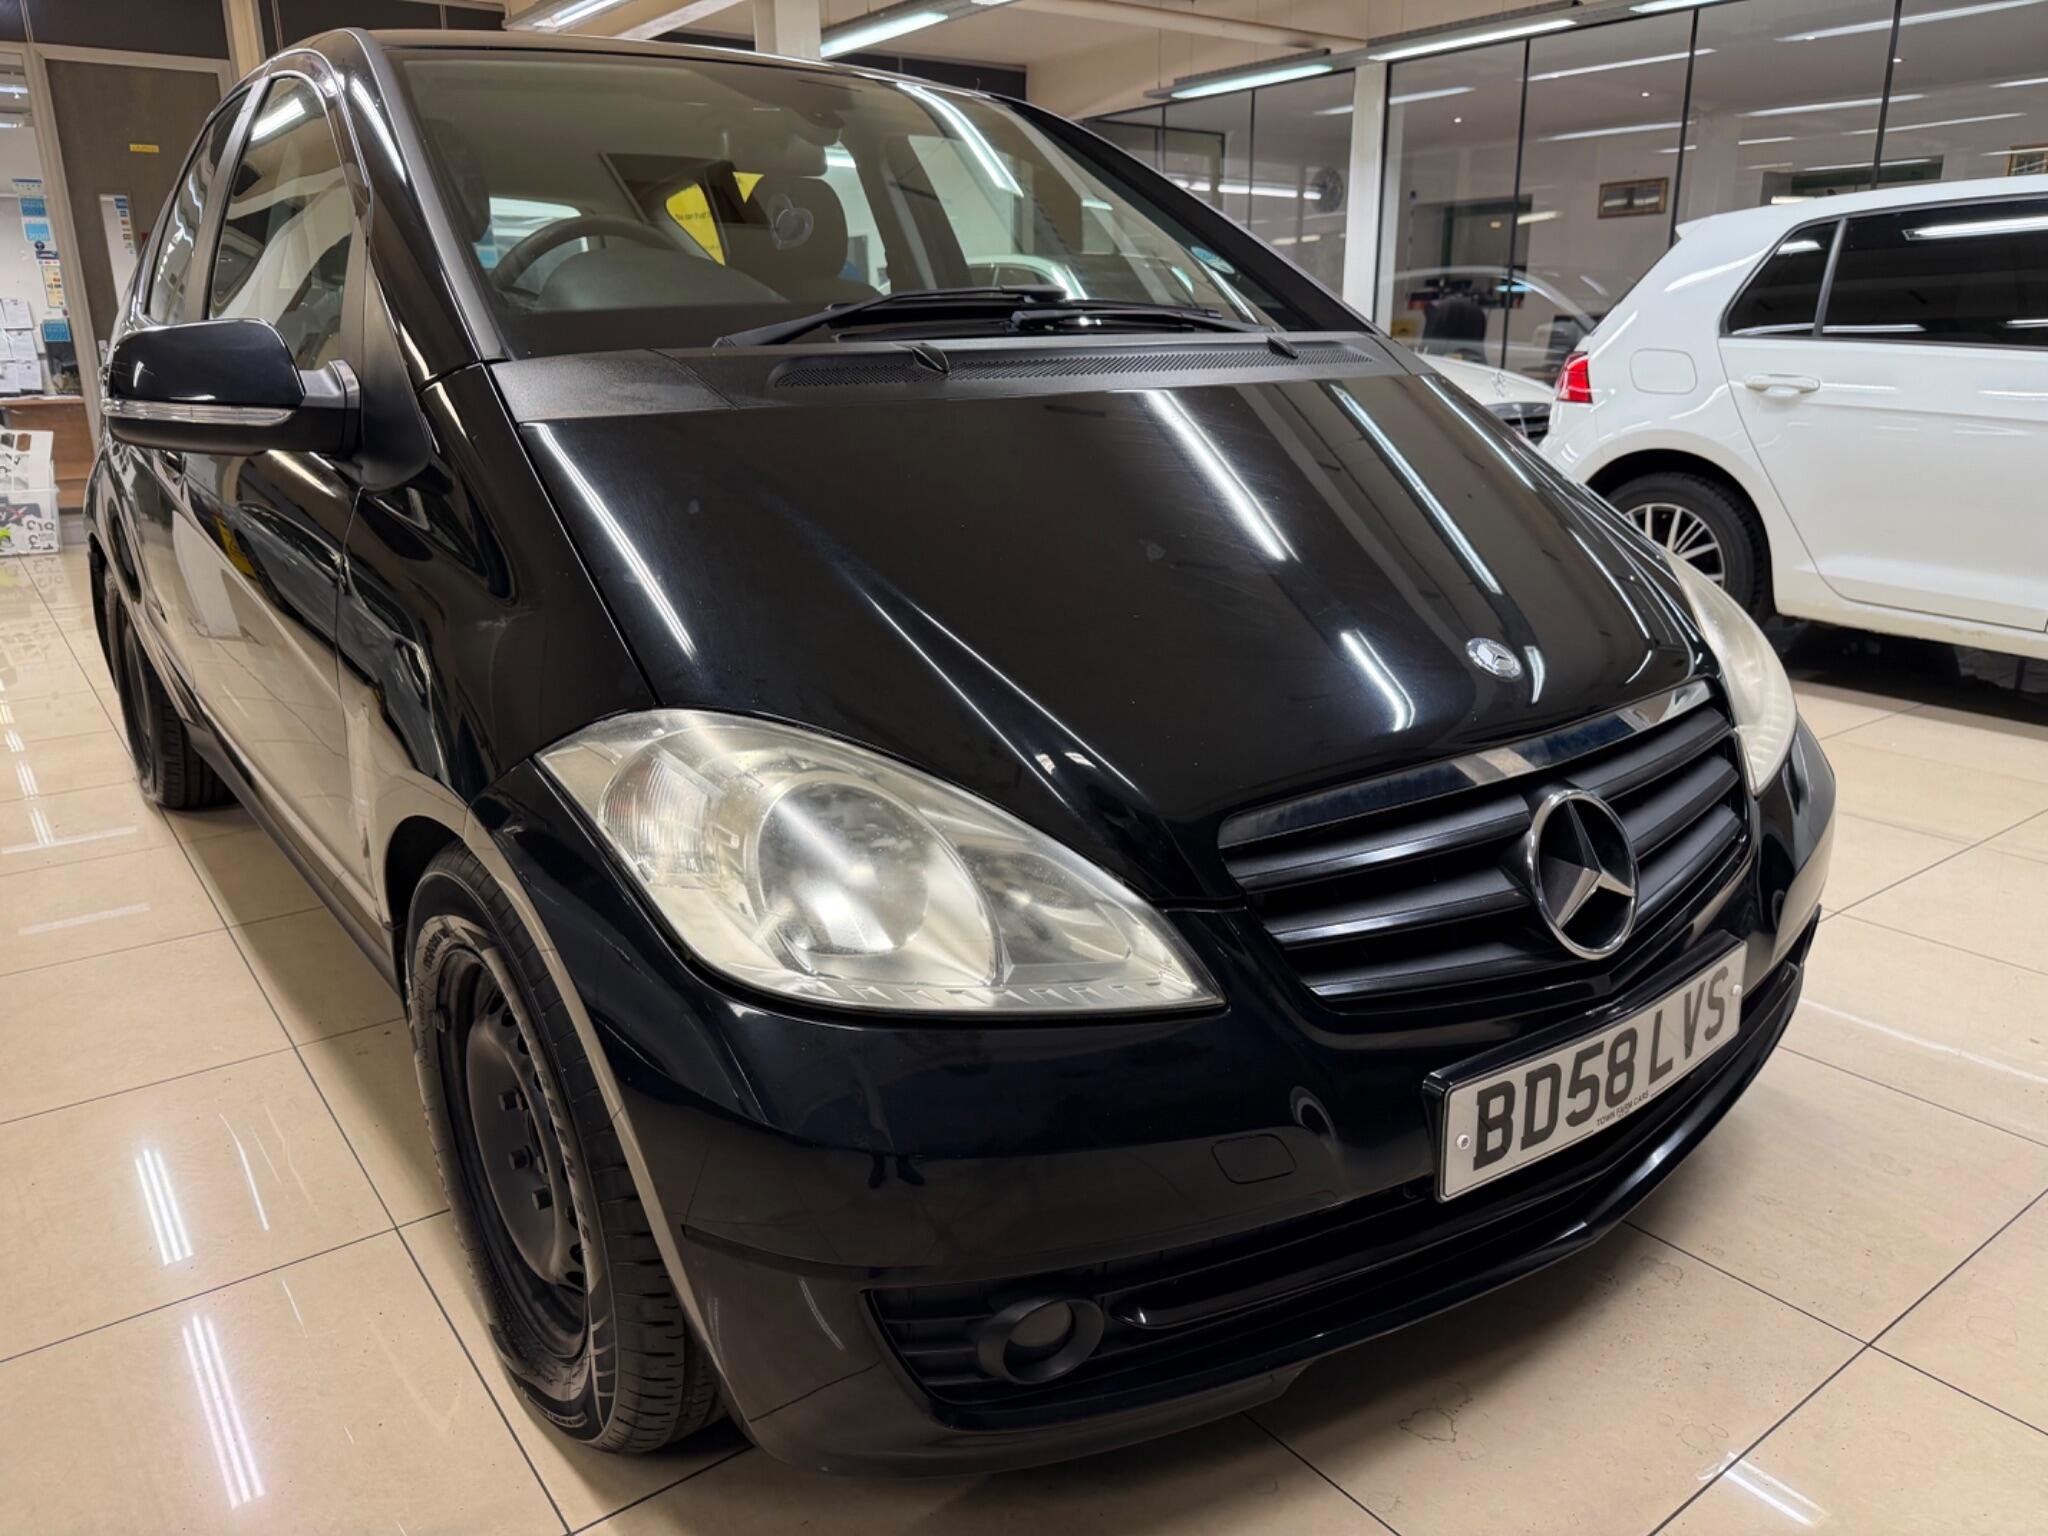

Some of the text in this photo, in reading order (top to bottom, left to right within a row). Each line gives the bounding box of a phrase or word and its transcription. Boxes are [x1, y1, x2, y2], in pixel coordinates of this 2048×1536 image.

[1473, 966, 1730, 1171] BD58 LVS
[1597, 1090, 1649, 1126] TOWN FARM CARS
